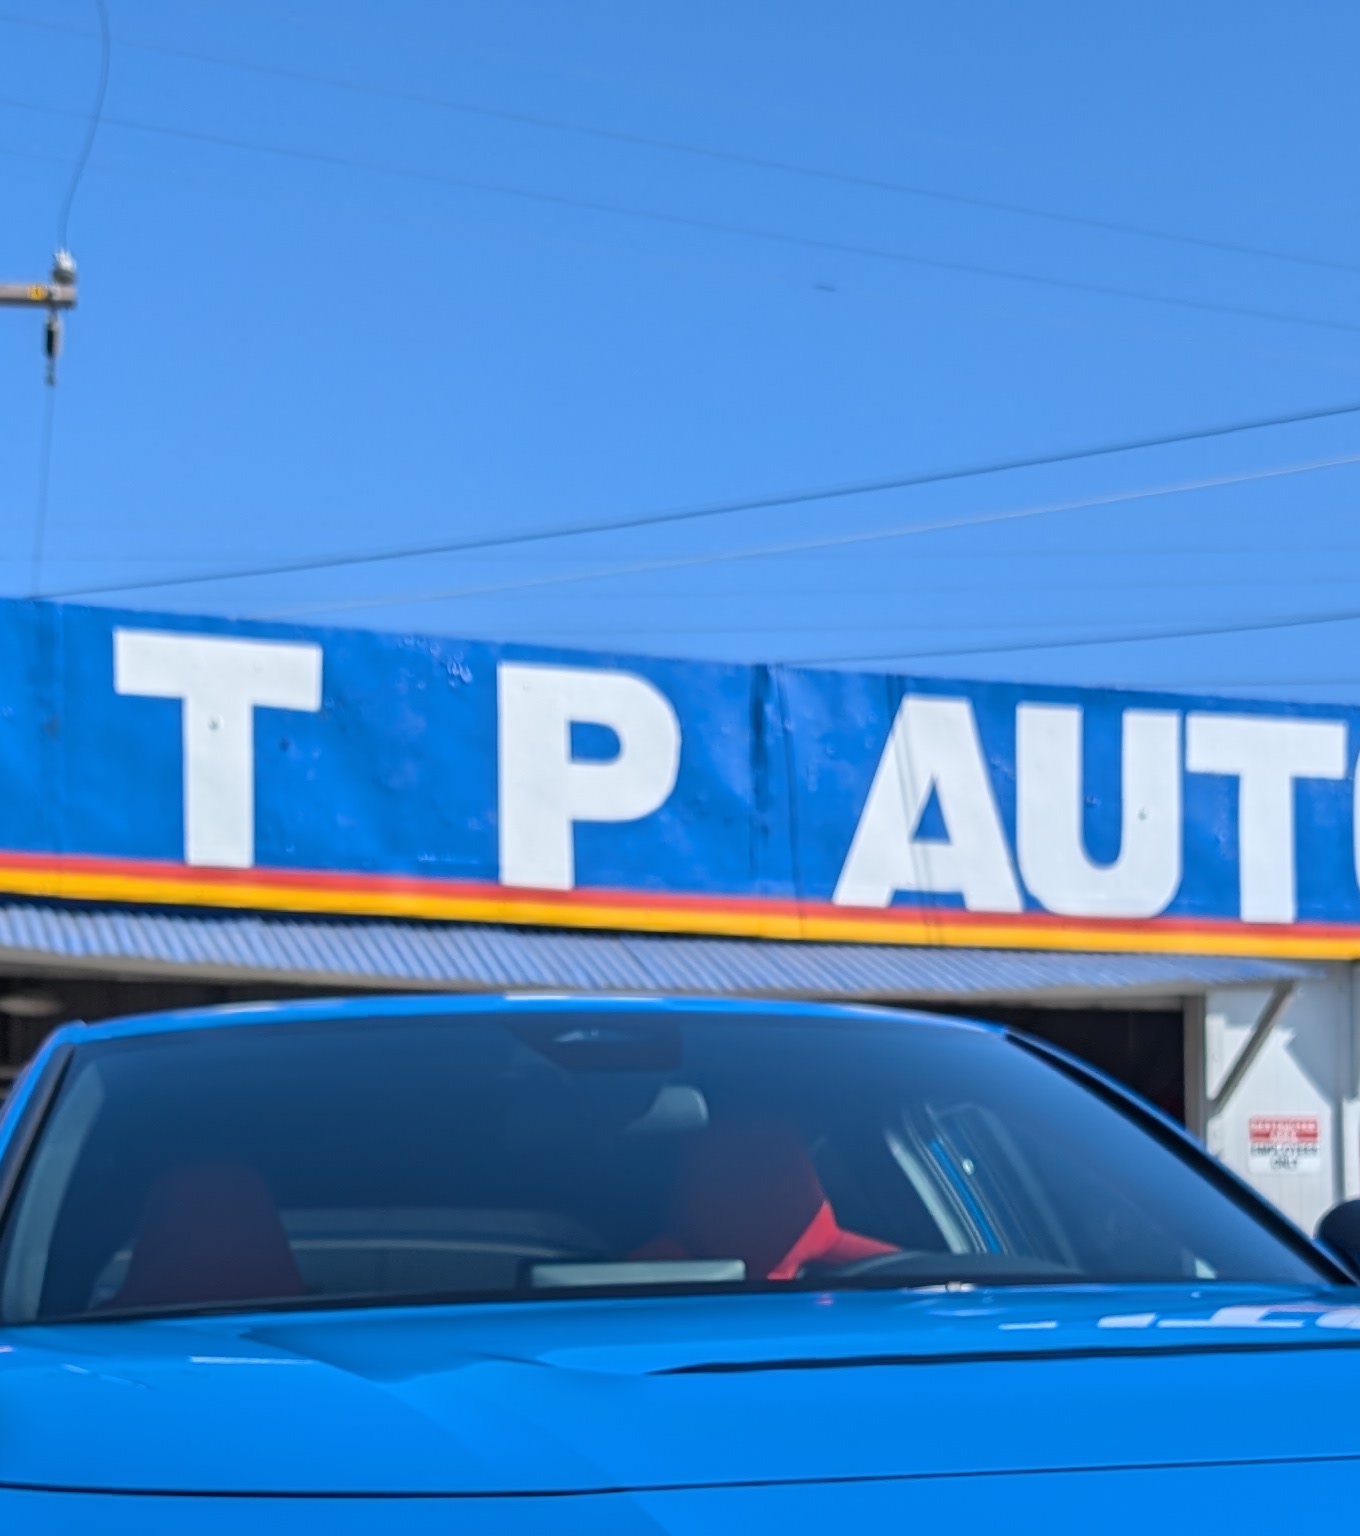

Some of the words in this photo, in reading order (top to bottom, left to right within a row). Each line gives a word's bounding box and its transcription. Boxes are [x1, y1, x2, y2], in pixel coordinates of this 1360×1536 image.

[115, 631, 321, 867] T
[499, 665, 680, 889] P
[1250, 1144, 1318, 1157] EMPLOYEES
[1269, 1156, 1298, 1169] ONLY
